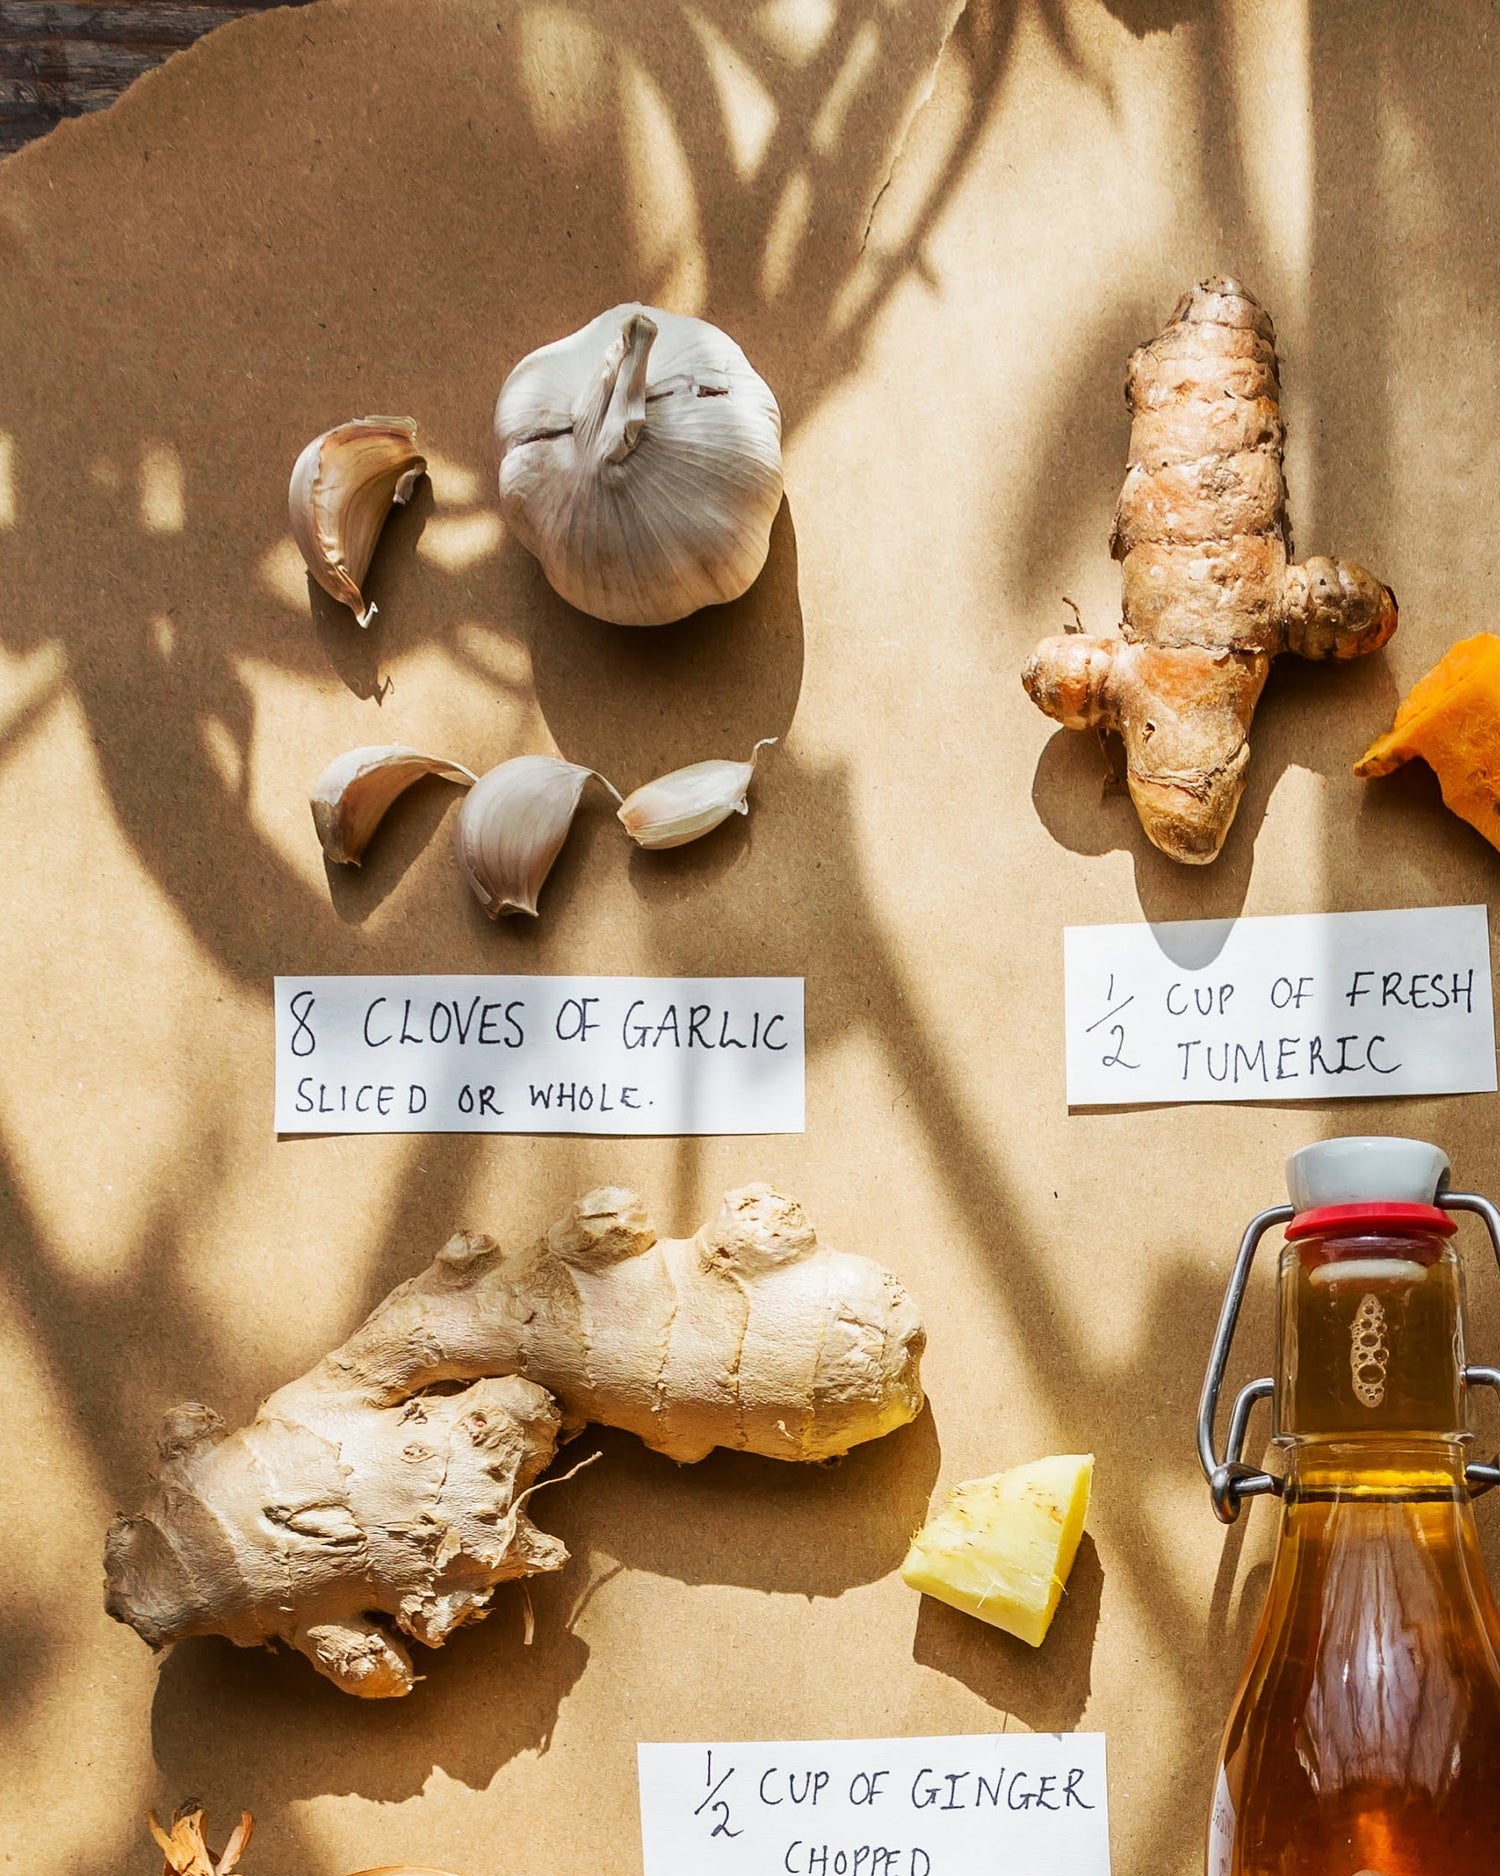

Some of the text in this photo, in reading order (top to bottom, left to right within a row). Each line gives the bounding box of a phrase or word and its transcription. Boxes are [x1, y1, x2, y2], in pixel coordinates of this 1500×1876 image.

[1166, 983, 1235, 1016] CUP
[1270, 977, 1314, 1009] OF
[1345, 968, 1474, 1014] FRESH
[289, 990, 788, 1057] 8 CLOVES OF GARLIC
[1177, 1034, 1402, 1084] TUMERIC
[295, 1077, 657, 1116] SLICED OR WHOLE.
[759, 1767, 830, 1806] CUP
[849, 1770, 890, 1806] OF
[911, 1767, 1096, 1811] GINGER
